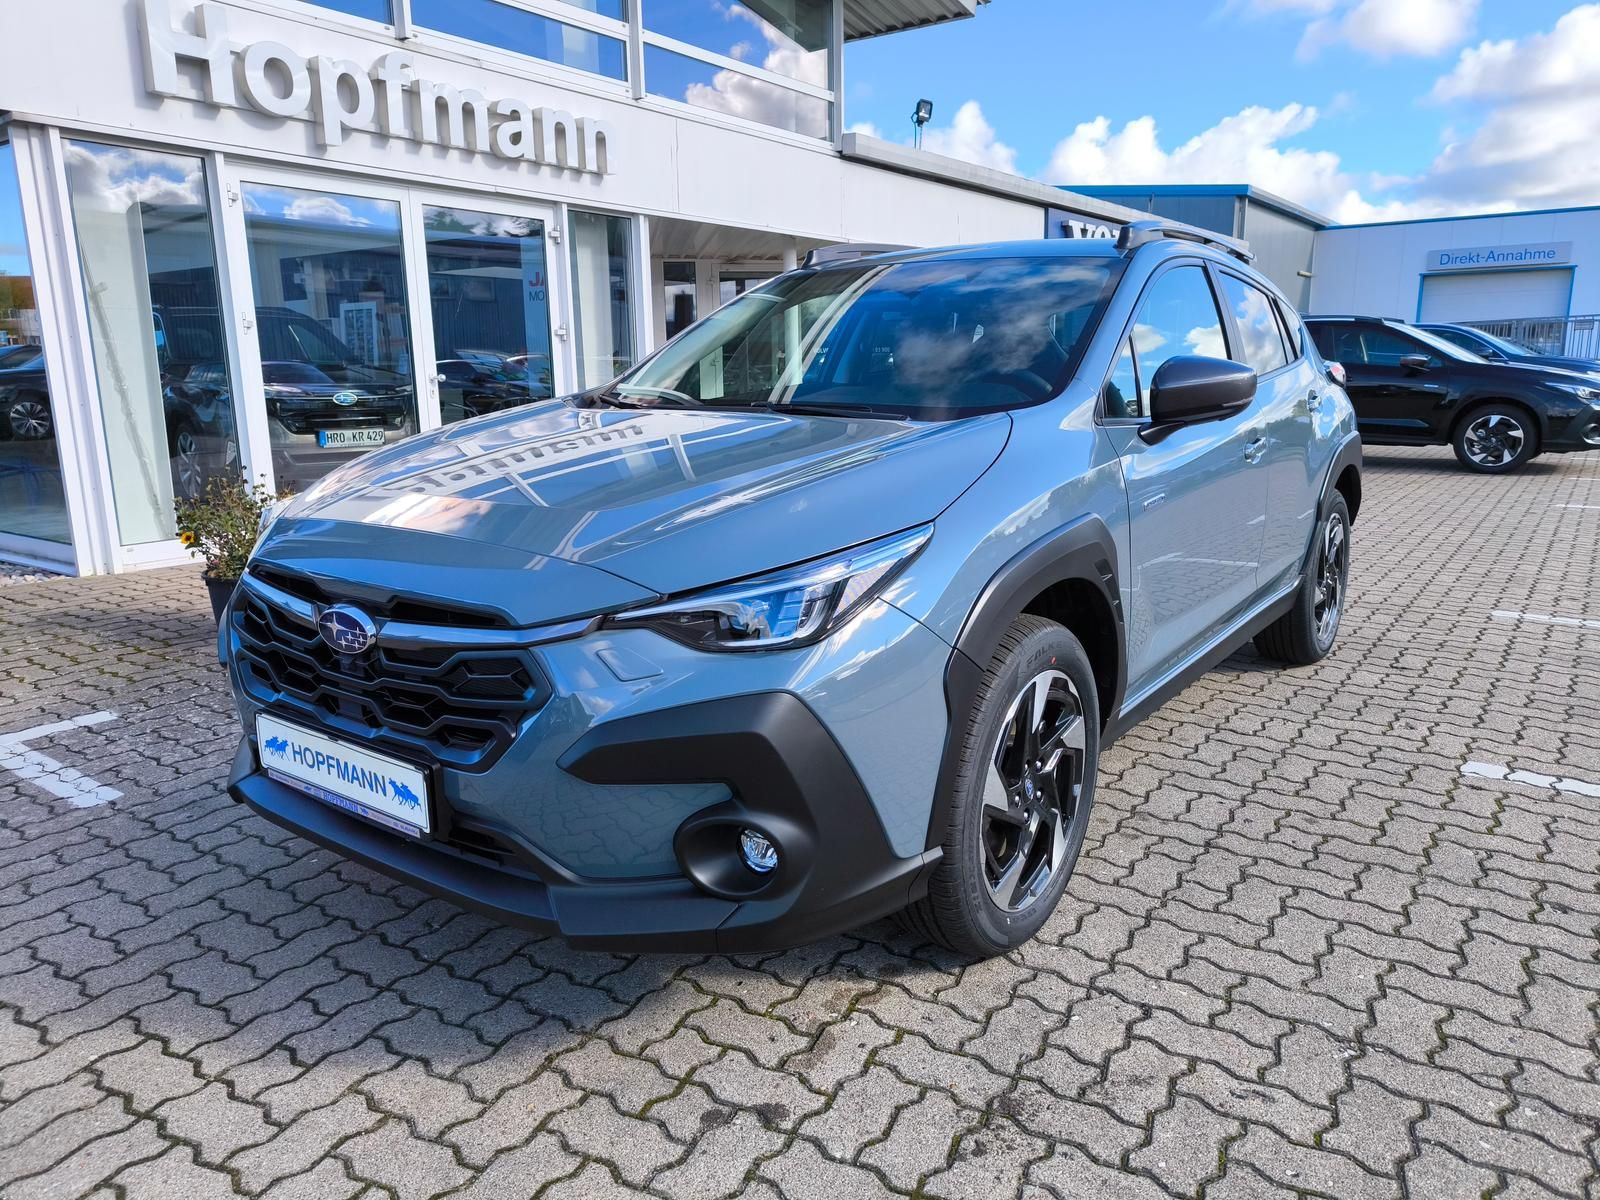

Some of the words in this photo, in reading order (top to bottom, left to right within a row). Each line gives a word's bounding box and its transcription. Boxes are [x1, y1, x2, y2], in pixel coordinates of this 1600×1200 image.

[140, 0, 616, 175] Hopfmann
[1440, 248, 1556, 266] Direkt-Annahme
[326, 432, 346, 444] HRO
[352, 431, 365, 442] KR
[367, 430, 384, 441] 429
[291, 742, 387, 797] HOPFMANN
